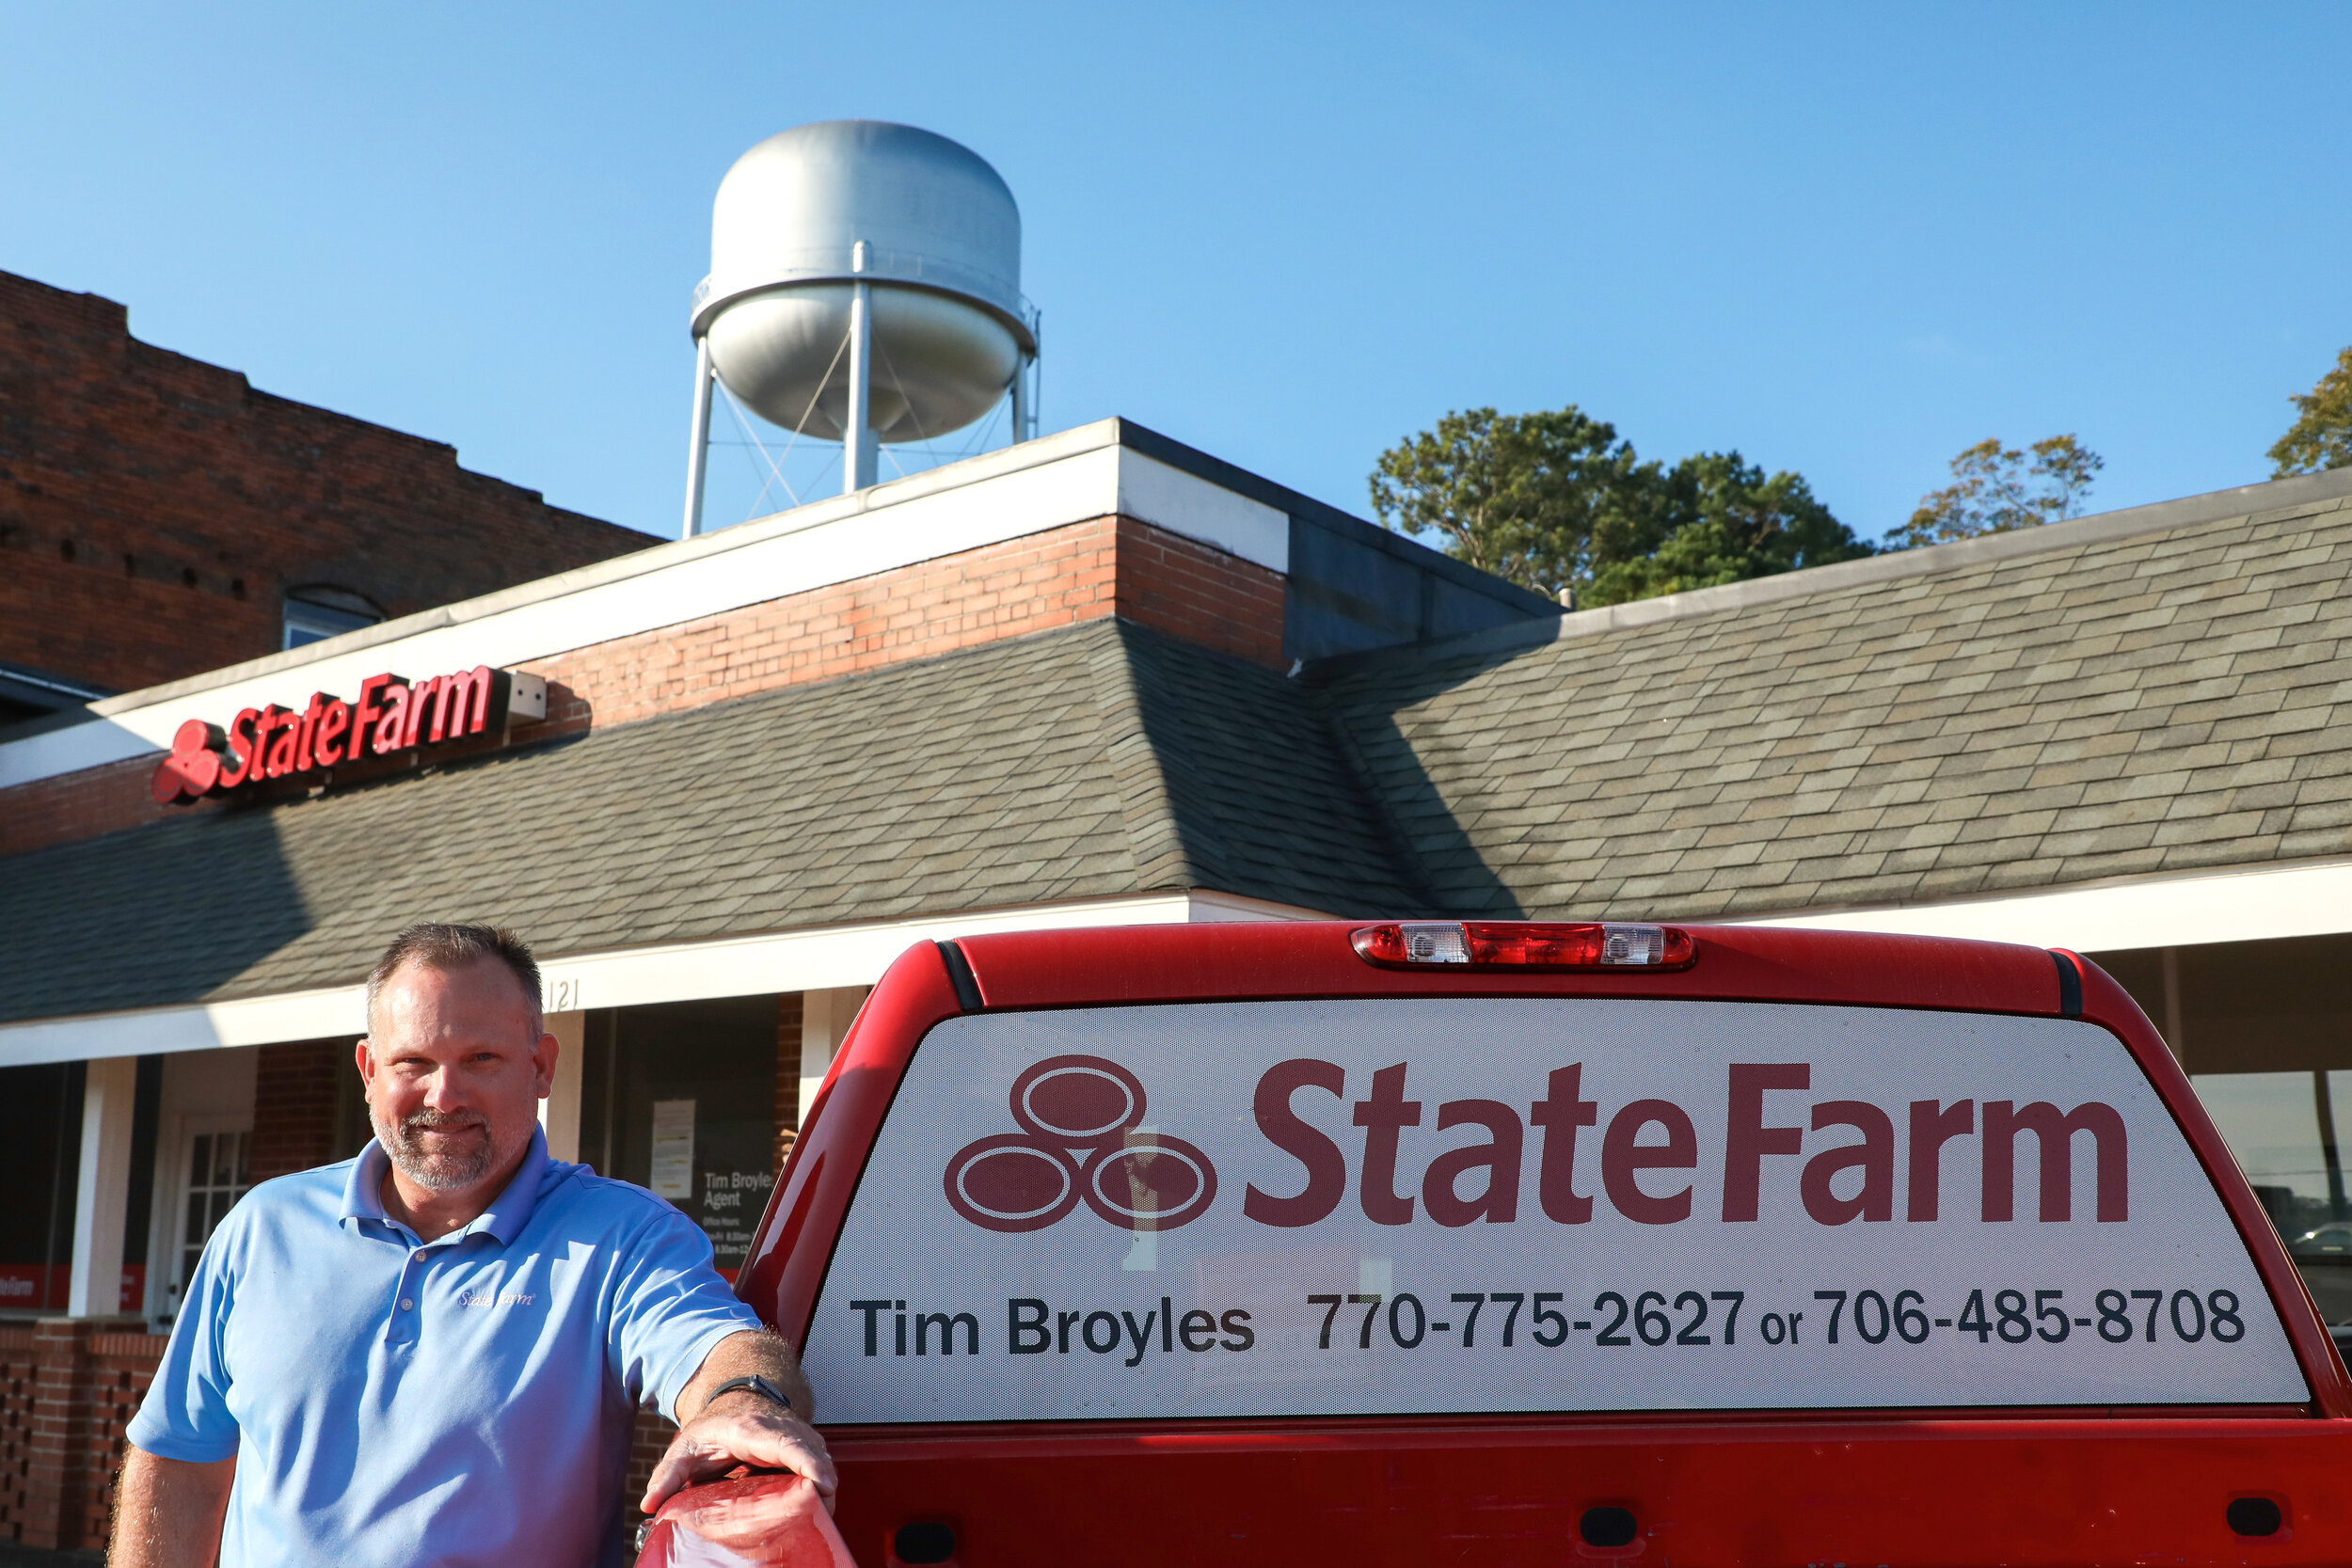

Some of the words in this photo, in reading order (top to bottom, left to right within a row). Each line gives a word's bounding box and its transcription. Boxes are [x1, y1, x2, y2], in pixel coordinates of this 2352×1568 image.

[548, 979, 579, 1012] 121
[705, 1173, 728, 1189] Tim
[705, 1191, 740, 1211] Agent
[458, 1291, 494, 1307] State
[850, 1298, 979, 1357] Tim
[1008, 1296, 1255, 1369] Broyles
[1307, 1290, 1745, 1350] 770-775-2627
[1759, 1310, 1804, 1346] or
[1813, 1288, 2247, 1345] 706-485-8708
